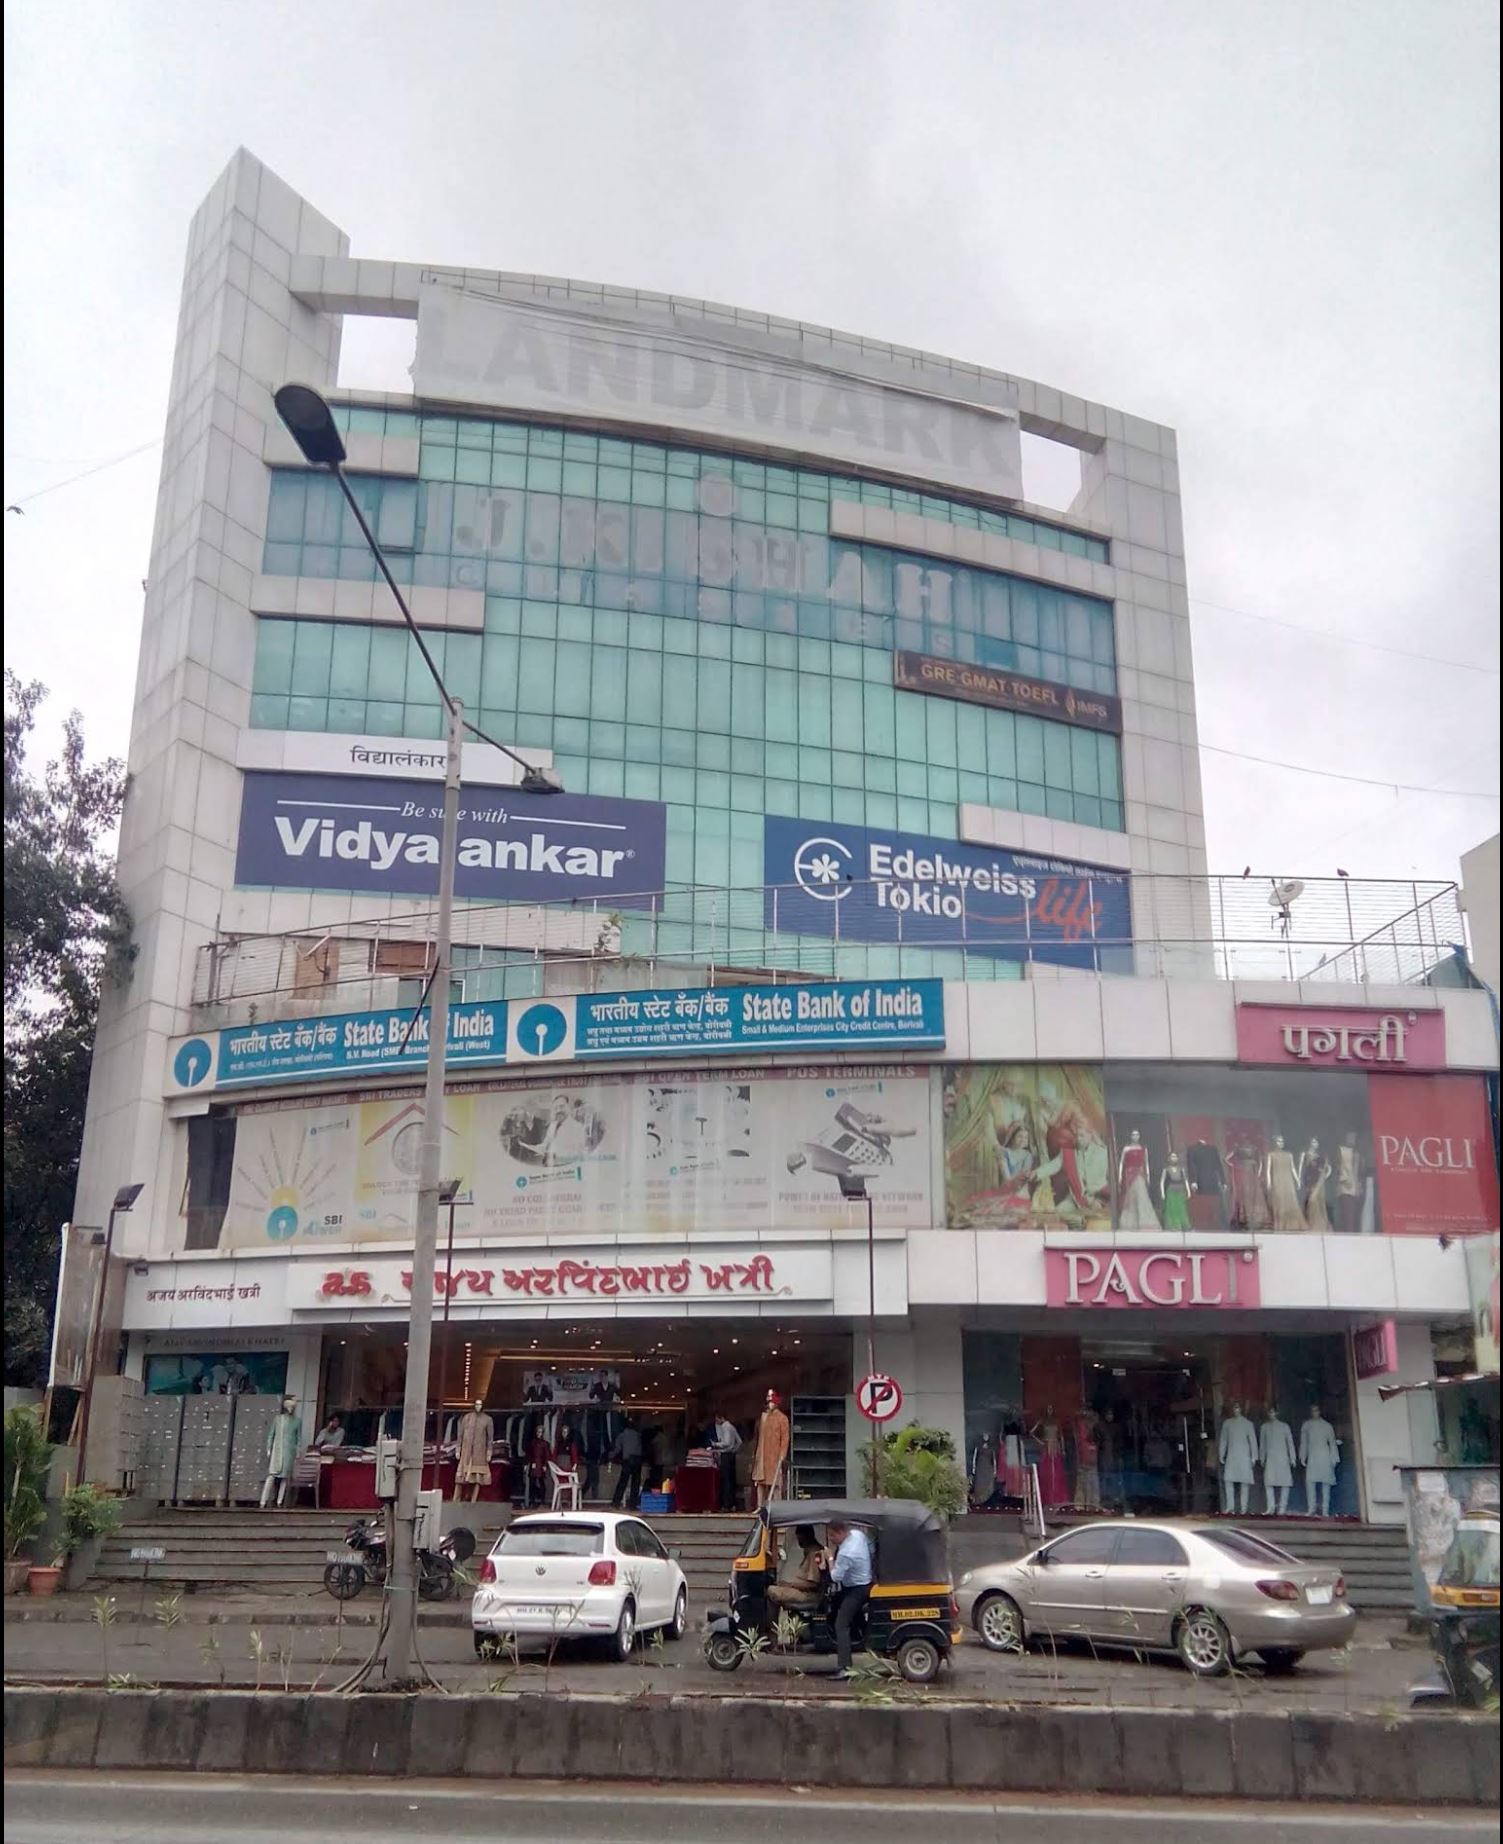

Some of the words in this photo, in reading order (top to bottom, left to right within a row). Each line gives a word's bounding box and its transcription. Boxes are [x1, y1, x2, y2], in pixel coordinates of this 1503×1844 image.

[422, 306, 1011, 473] LANDMARK
[920, 664, 956, 683] GRE
[961, 671, 1007, 694] GMAT
[1011, 680, 1059, 706] TOEFL
[401, 801, 425, 817] Be
[428, 807, 467, 821] sue
[471, 808, 508, 824] with
[273, 815, 625, 879] Vidyaankar
[869, 843, 1037, 900] Edelweiss
[868, 881, 963, 919] Tokio
[590, 996, 639, 1022] भारतीय
[643, 994, 671, 1018] स्टेट
[742, 992, 792, 1021] State
[798, 990, 846, 1019] Bank
[851, 988, 871, 1017] of
[875, 986, 923, 1017] India
[343, 1019, 385, 1049] State
[388, 1015, 430, 1044] Bank
[453, 1008, 494, 1038] India
[768, 1023, 795, 1034] Medium
[836, 1021, 849, 1033] City
[850, 1020, 871, 1031] Credit
[1281, 1013, 1409, 1063] पगली
[229, 1030, 267, 1057] भारतीय
[731, 1069, 765, 1080] LOAN
[825, 1065, 917, 1079] TERMINALS
[1378, 1134, 1476, 1170] PAGLI
[324, 1214, 343, 1225] SBI
[146, 1288, 175, 1302] अजय
[237, 1282, 262, 1300] खत्री
[1062, 1250, 1245, 1305] PAGLI
